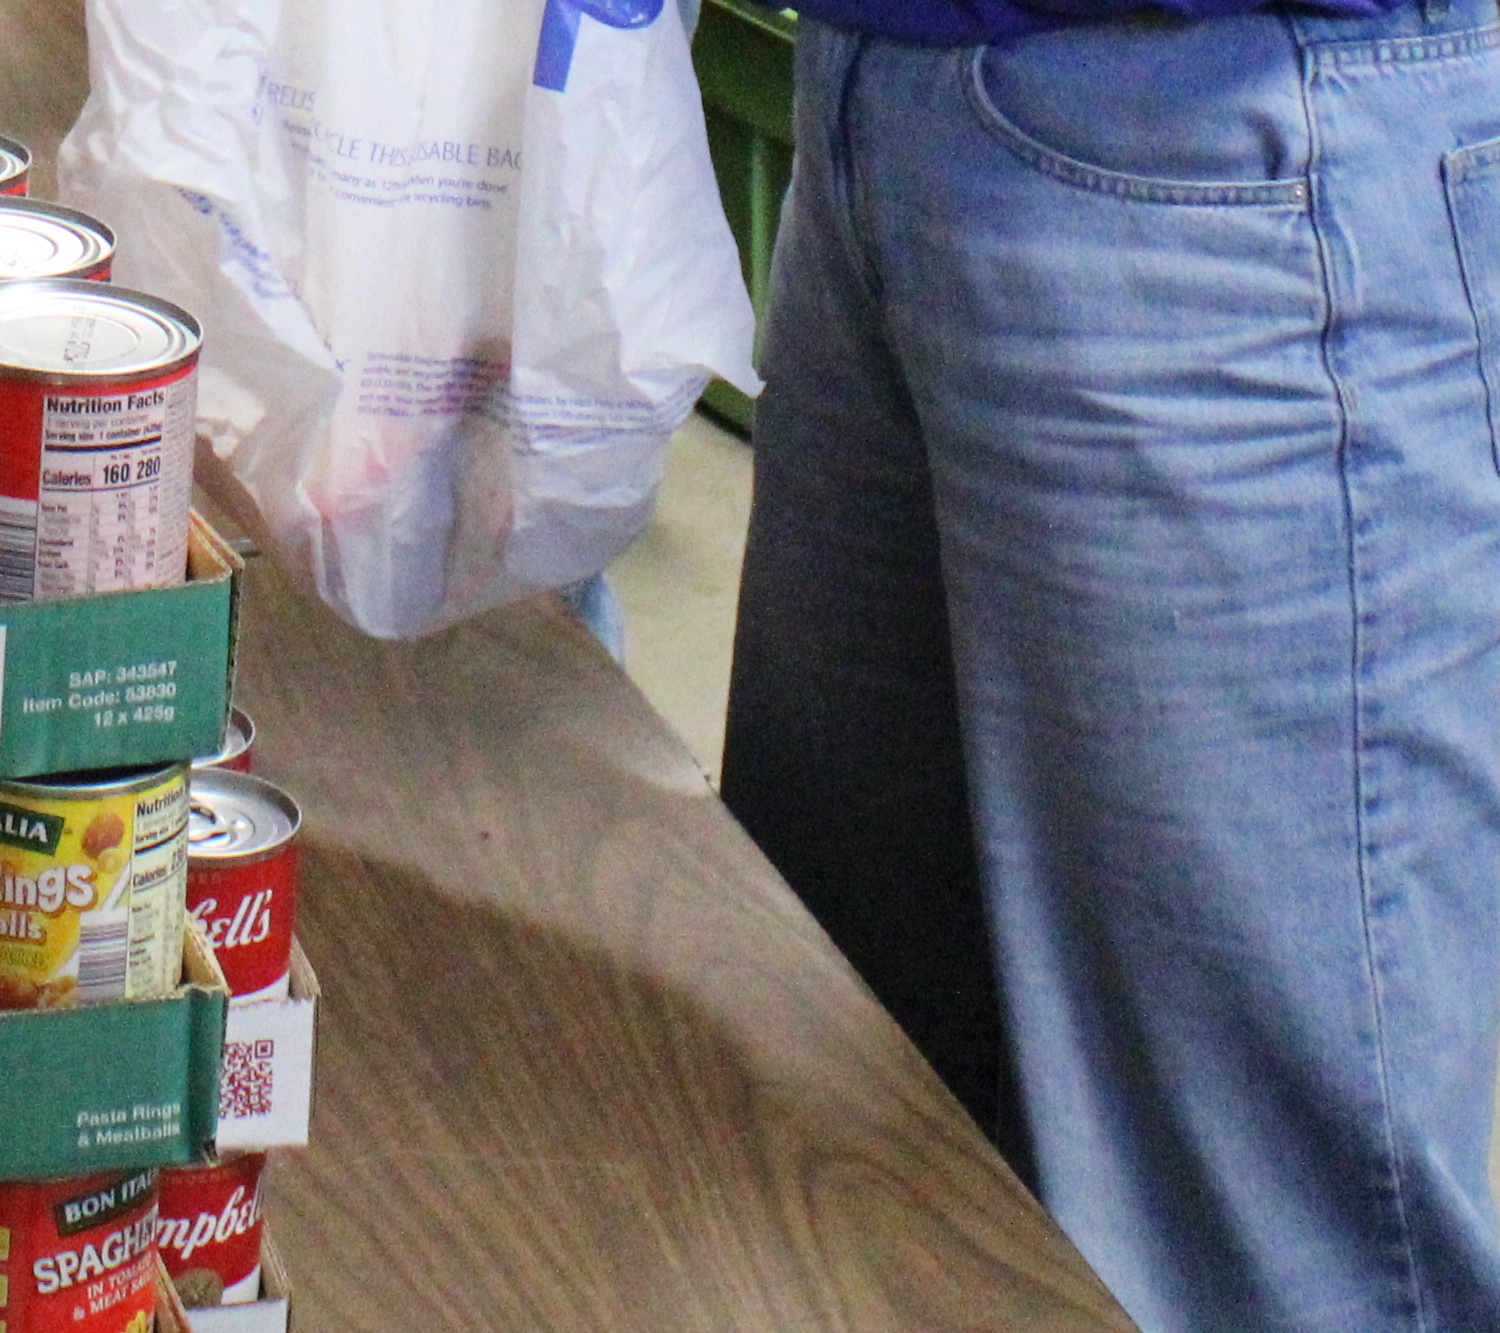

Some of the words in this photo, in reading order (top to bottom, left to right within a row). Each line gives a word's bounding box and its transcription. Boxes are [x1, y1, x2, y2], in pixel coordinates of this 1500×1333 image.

[46, 393, 124, 416] Nutrition
[126, 389, 166, 411] Facts
[45, 429, 77, 443] Serving
[78, 430, 96, 442] size
[106, 426, 143, 440] container
[55, 417, 91, 431] serving
[92, 417, 111, 430] per
[112, 413, 150, 427] container
[42, 469, 92, 486] Calories
[102, 463, 132, 486] 160
[136, 455, 162, 482] 280
[68, 668, 112, 689] SAP:
[21, 695, 63, 715] Item
[67, 689, 122, 711] Code:
[93, 709, 115, 729] 12
[117, 711, 129, 727] x
[133, 865, 167, 887] Calories
[76, 1111, 127, 1129] Pasta
[130, 1103, 182, 1126] Rings
[76, 1132, 92, 1149] &
[95, 1121, 182, 1147] Meatballs
[64, 1188, 116, 1224] BON
[72, 1304, 86, 1321] &
[89, 1287, 128, 1315] MEAT
[86, 1281, 105, 1301] IN
